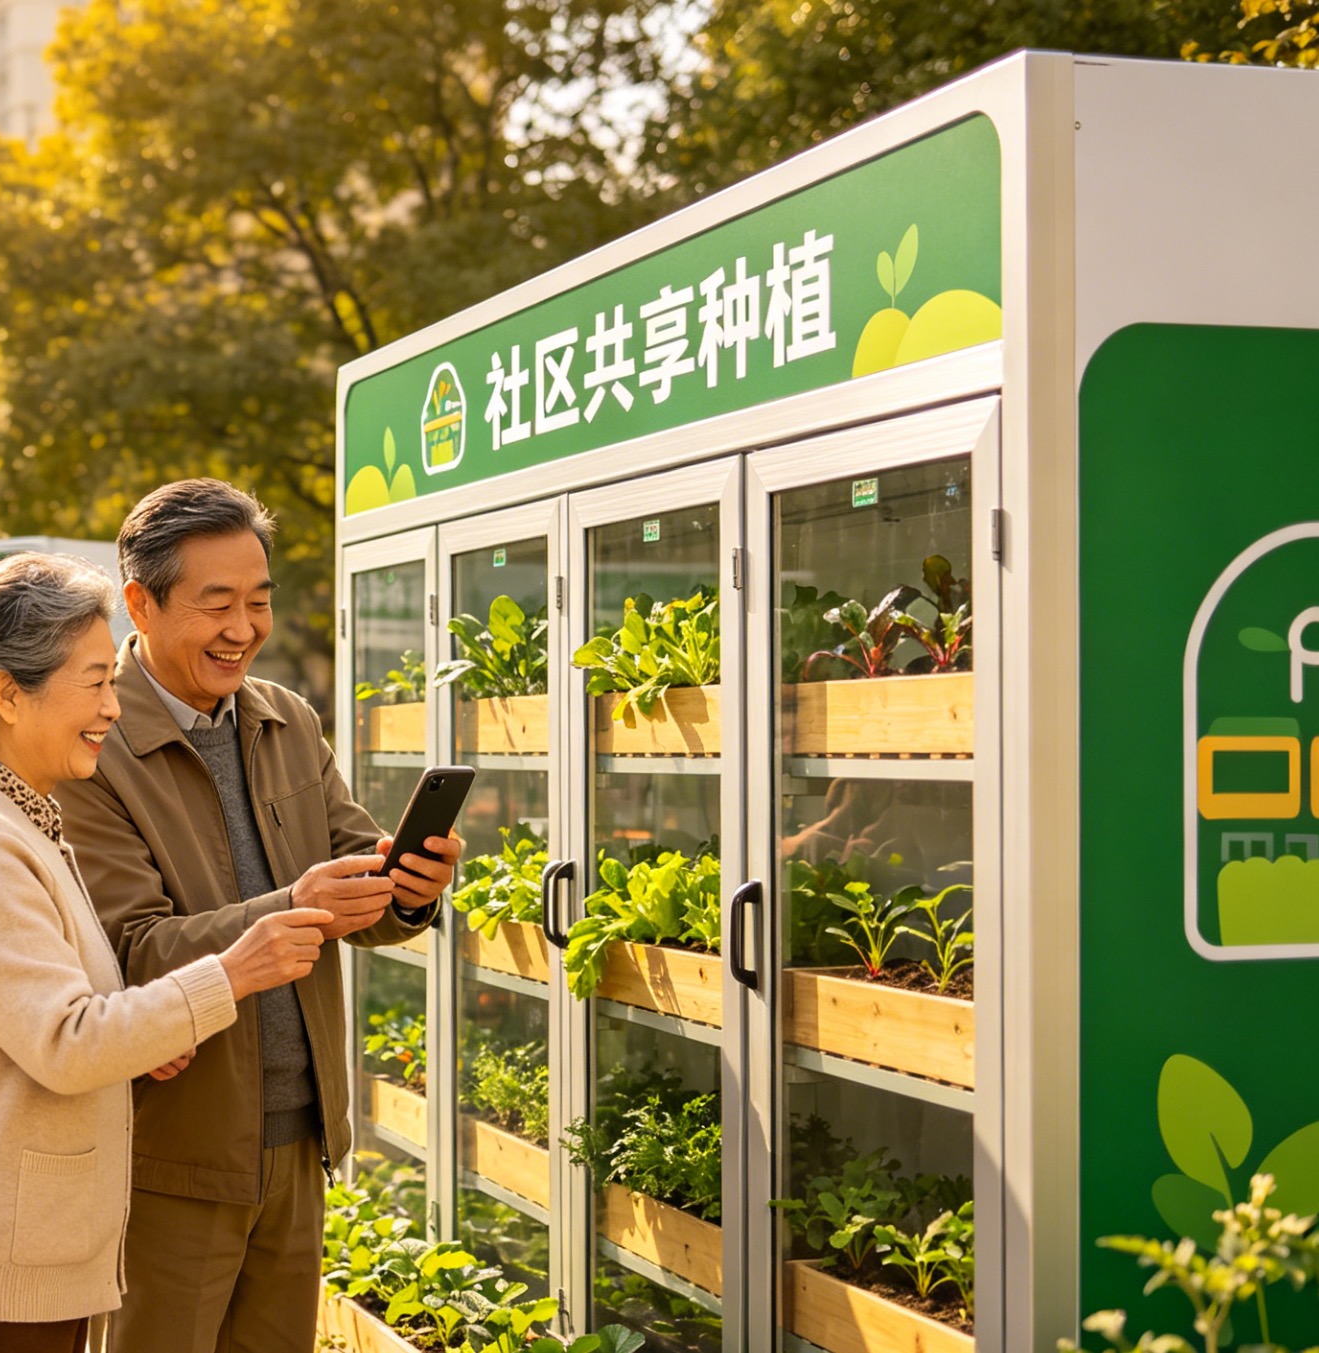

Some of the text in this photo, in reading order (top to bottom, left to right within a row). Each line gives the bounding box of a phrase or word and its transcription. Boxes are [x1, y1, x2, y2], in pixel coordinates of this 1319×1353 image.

[484, 228, 837, 451] 社区共享种植
